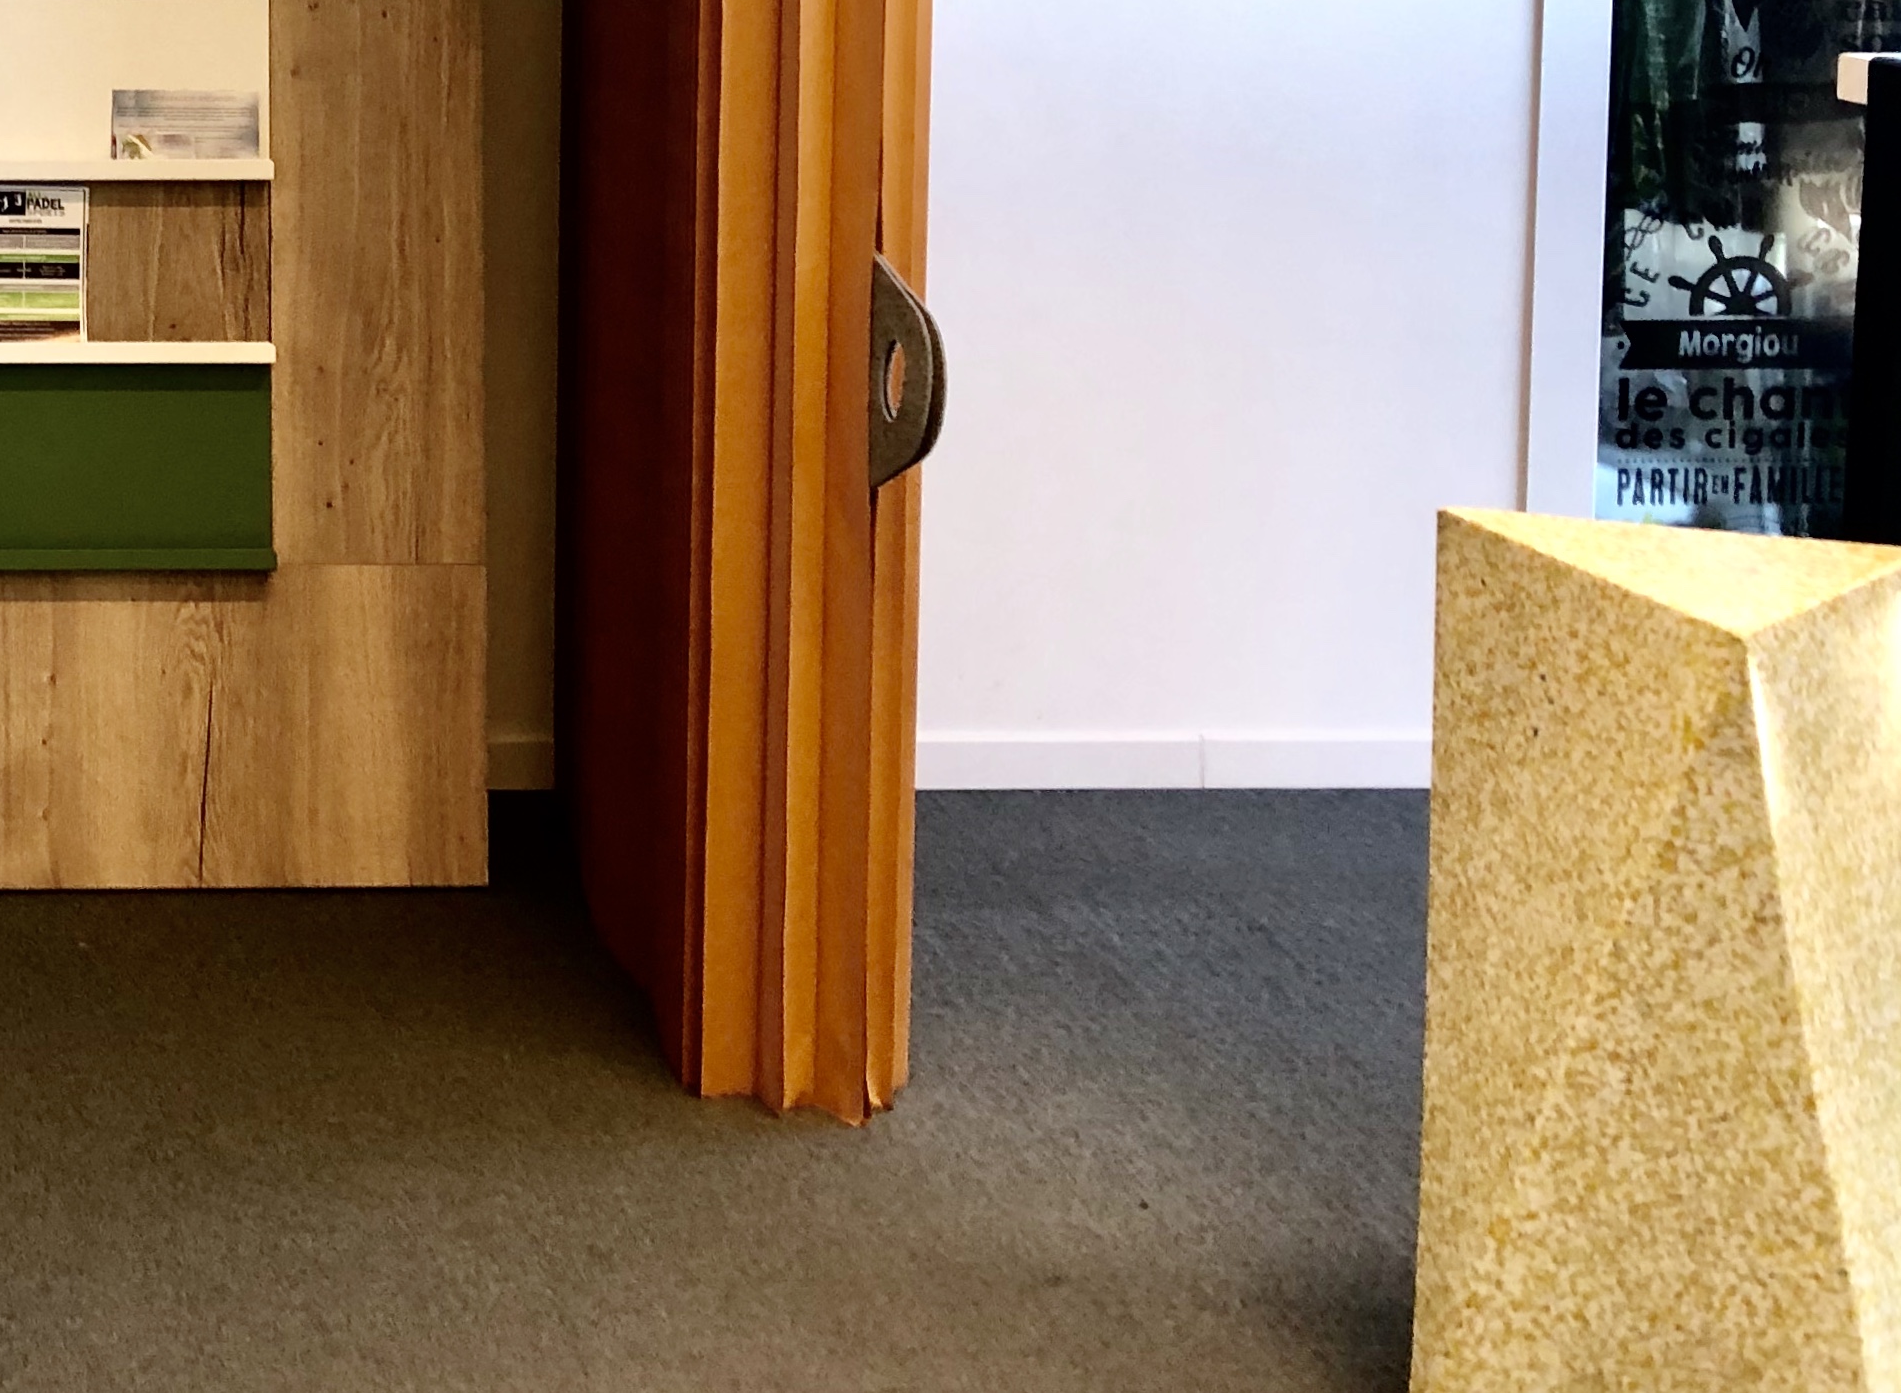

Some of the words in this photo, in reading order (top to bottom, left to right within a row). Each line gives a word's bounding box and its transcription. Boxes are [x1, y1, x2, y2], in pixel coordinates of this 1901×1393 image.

[27, 198, 65, 210] PADEL
[1678, 325, 1799, 364] Morgiou
[1617, 377, 1668, 421] le
[1615, 420, 1686, 449] des
[1616, 467, 1708, 505] PARTIR
[1711, 474, 1729, 494] EN
[1733, 465, 1843, 505] FAMILLE
